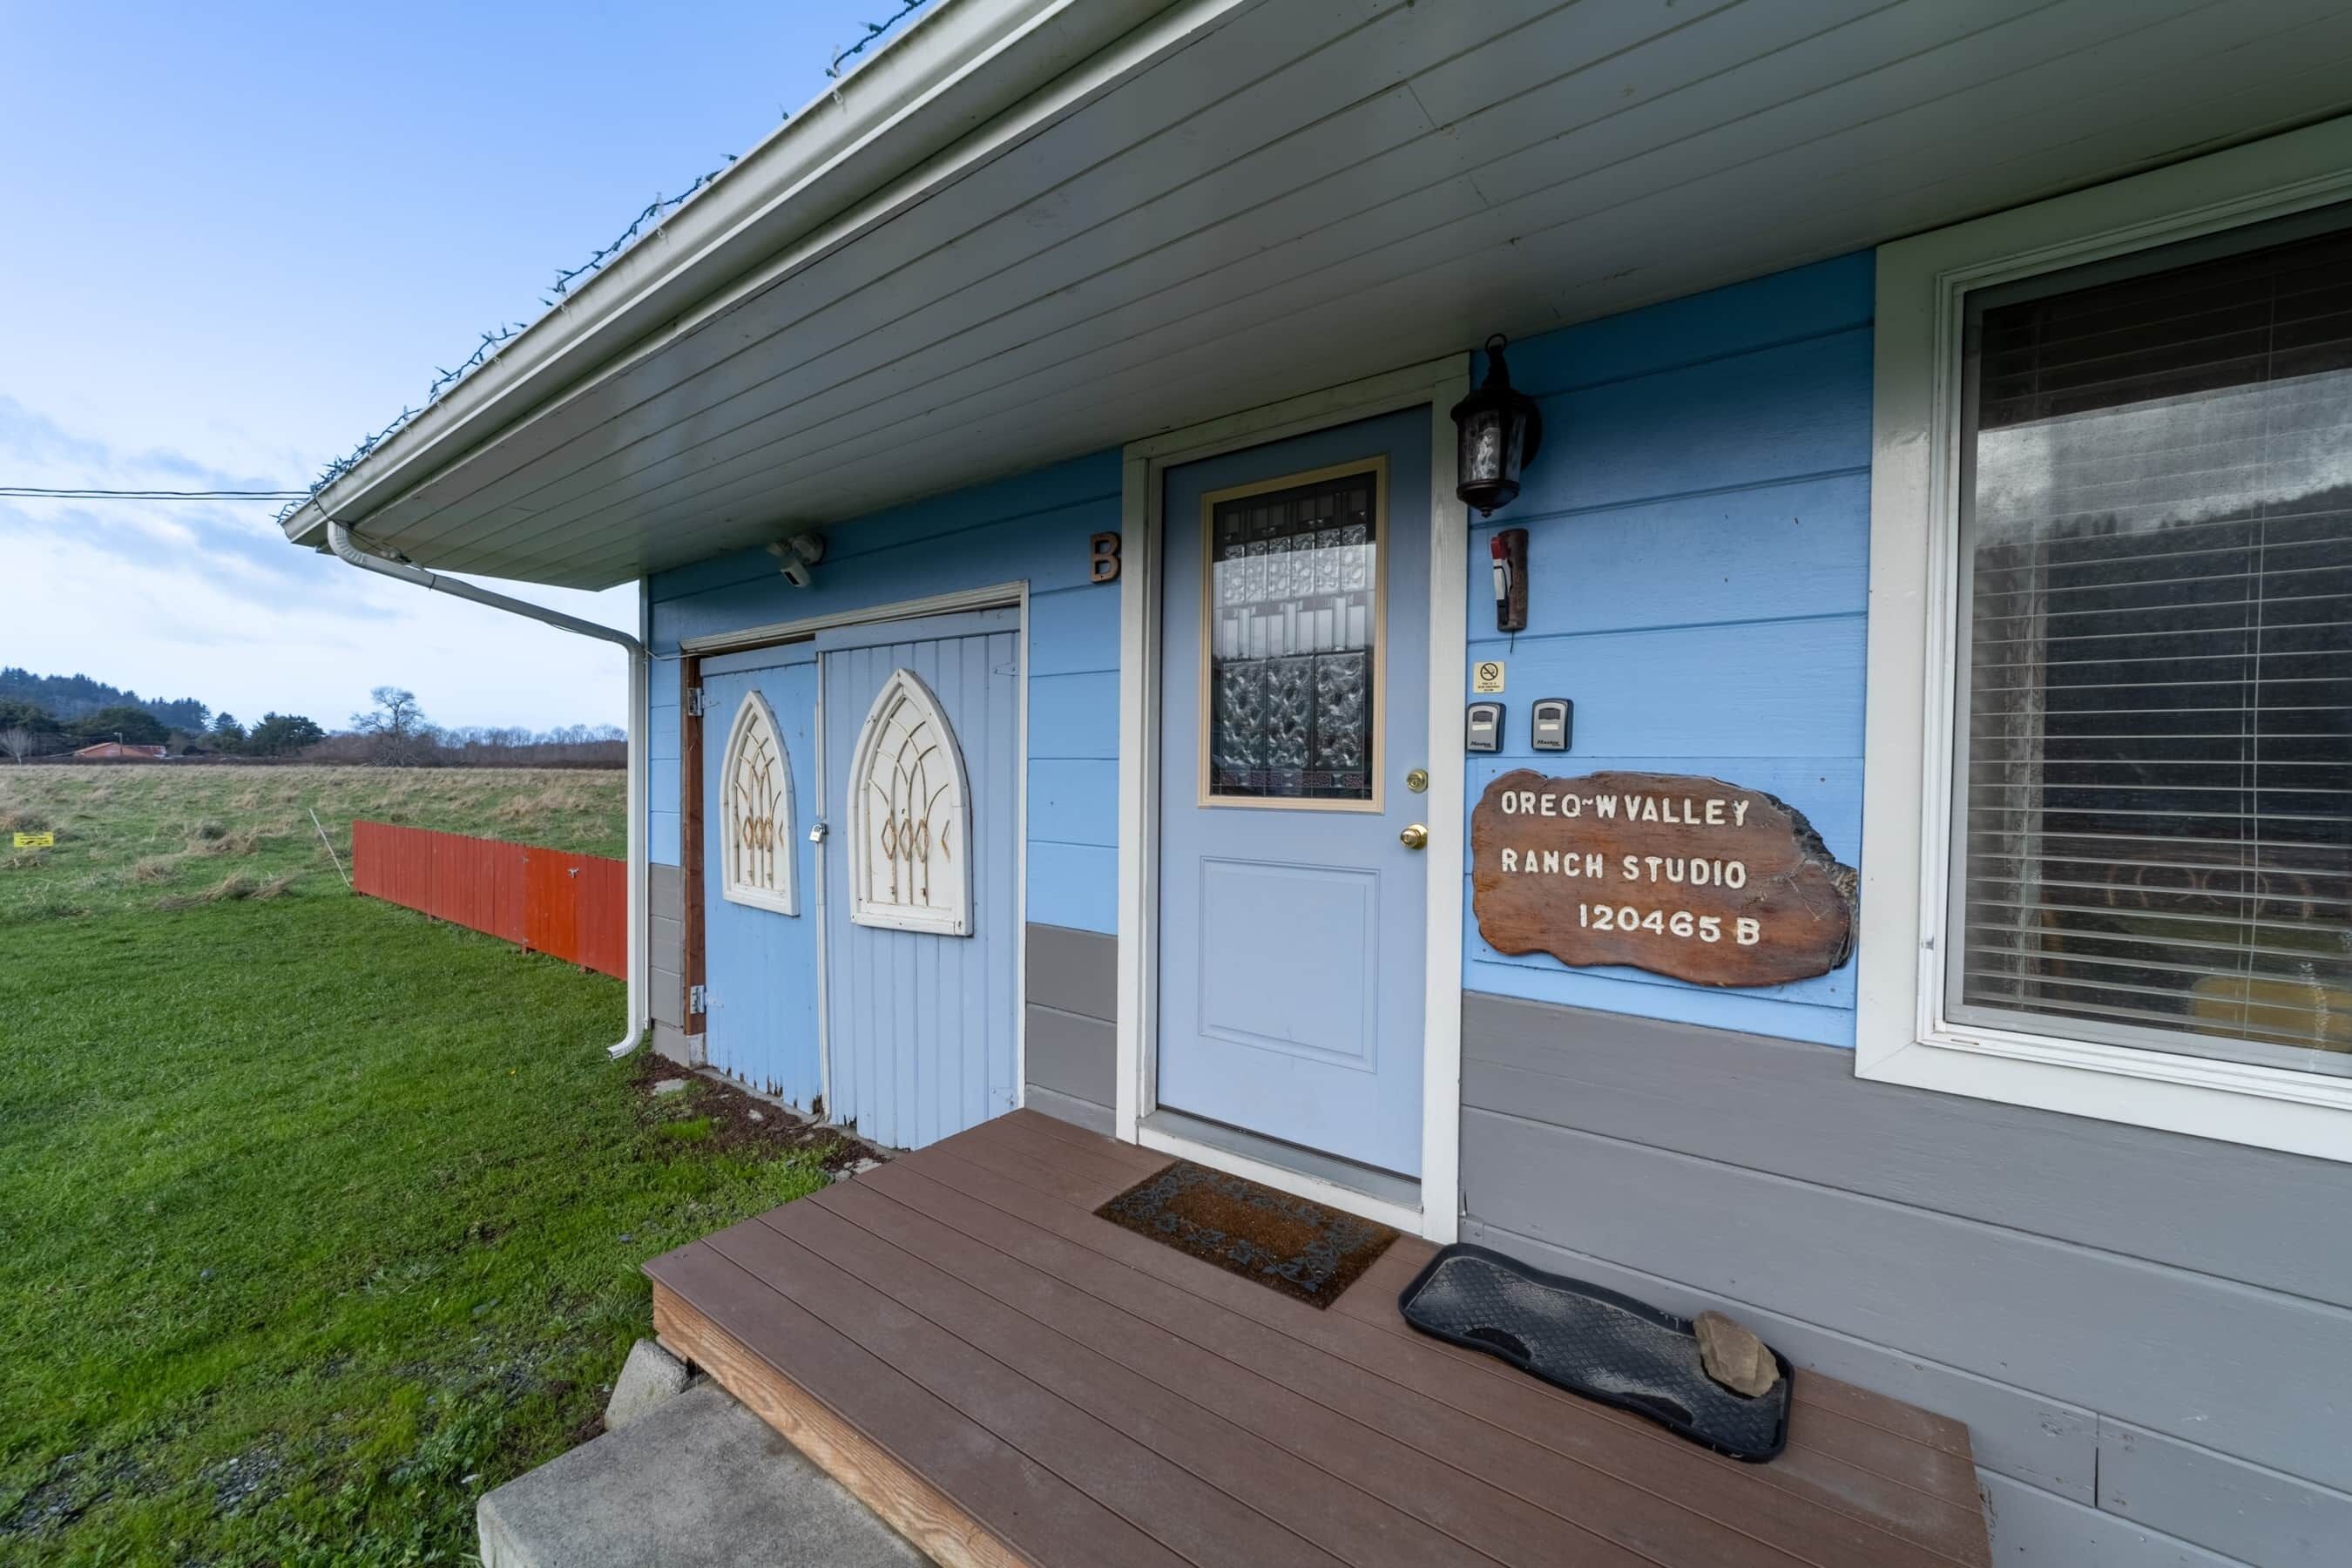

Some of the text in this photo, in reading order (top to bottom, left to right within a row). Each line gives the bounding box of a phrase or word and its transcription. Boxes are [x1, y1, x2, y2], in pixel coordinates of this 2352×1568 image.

[1090, 531, 1121, 585] B
[1625, 794, 1749, 826] VALLEY
[1501, 848, 1747, 889] RANCH STUDIO
[1579, 903, 1761, 946] 120465 B
